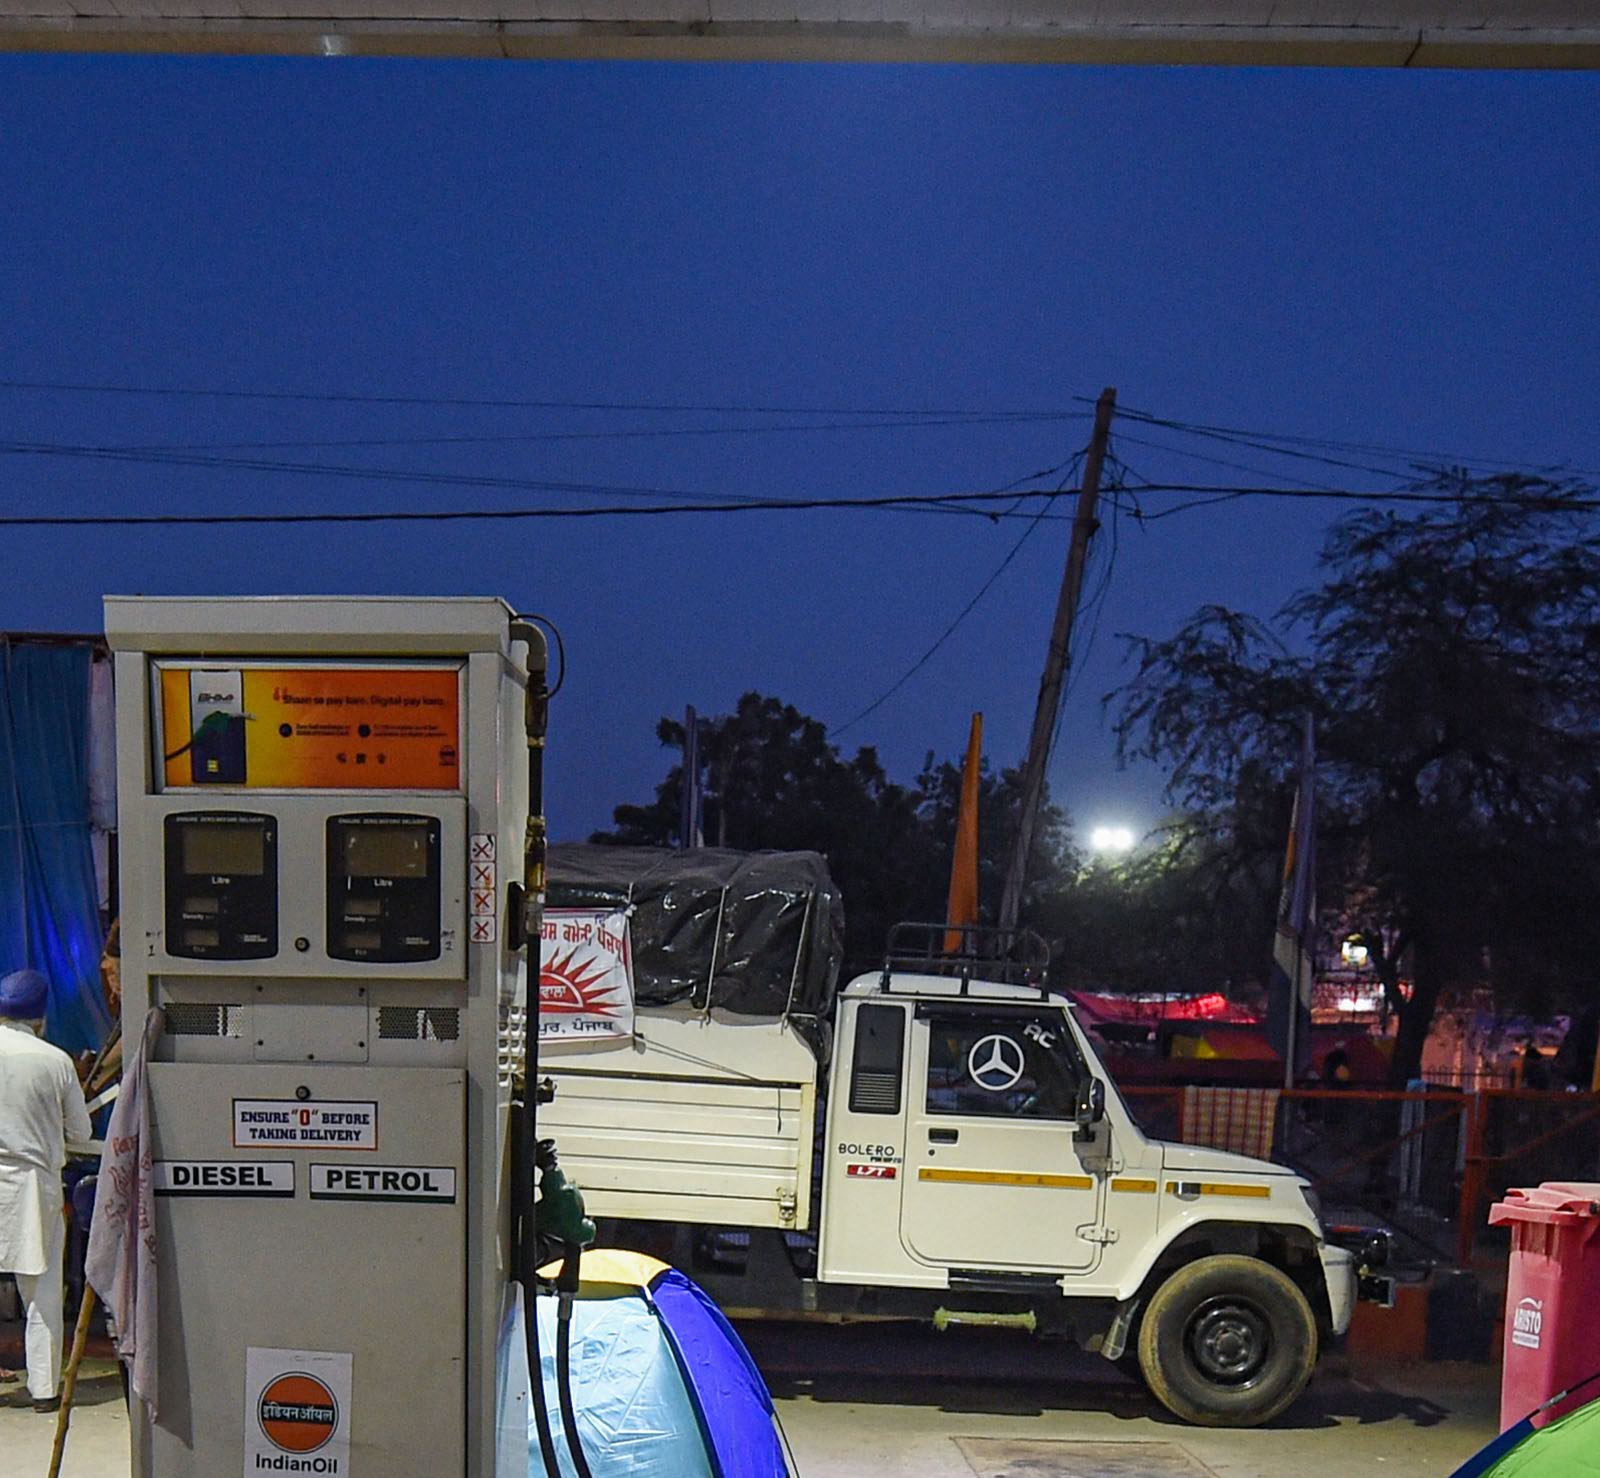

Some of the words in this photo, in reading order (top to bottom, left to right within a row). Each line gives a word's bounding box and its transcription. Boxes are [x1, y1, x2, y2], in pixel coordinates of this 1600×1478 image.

[211, 875, 231, 885] Litre
[373, 878, 393, 888] Litre
[1023, 1024, 1057, 1048] AC
[241, 1111, 289, 1123] ENSURE
[322, 1113, 370, 1125] BEFORE
[249, 1128, 297, 1140] TAKING
[300, 1129, 361, 1141] DELIVERY
[838, 1143, 895, 1156] BOLERO
[173, 1166, 272, 1186] DIESEL
[327, 1169, 438, 1192] PETROL
[1513, 1307, 1542, 1334] ARISTO
[256, 1453, 337, 1473] IndianOil
